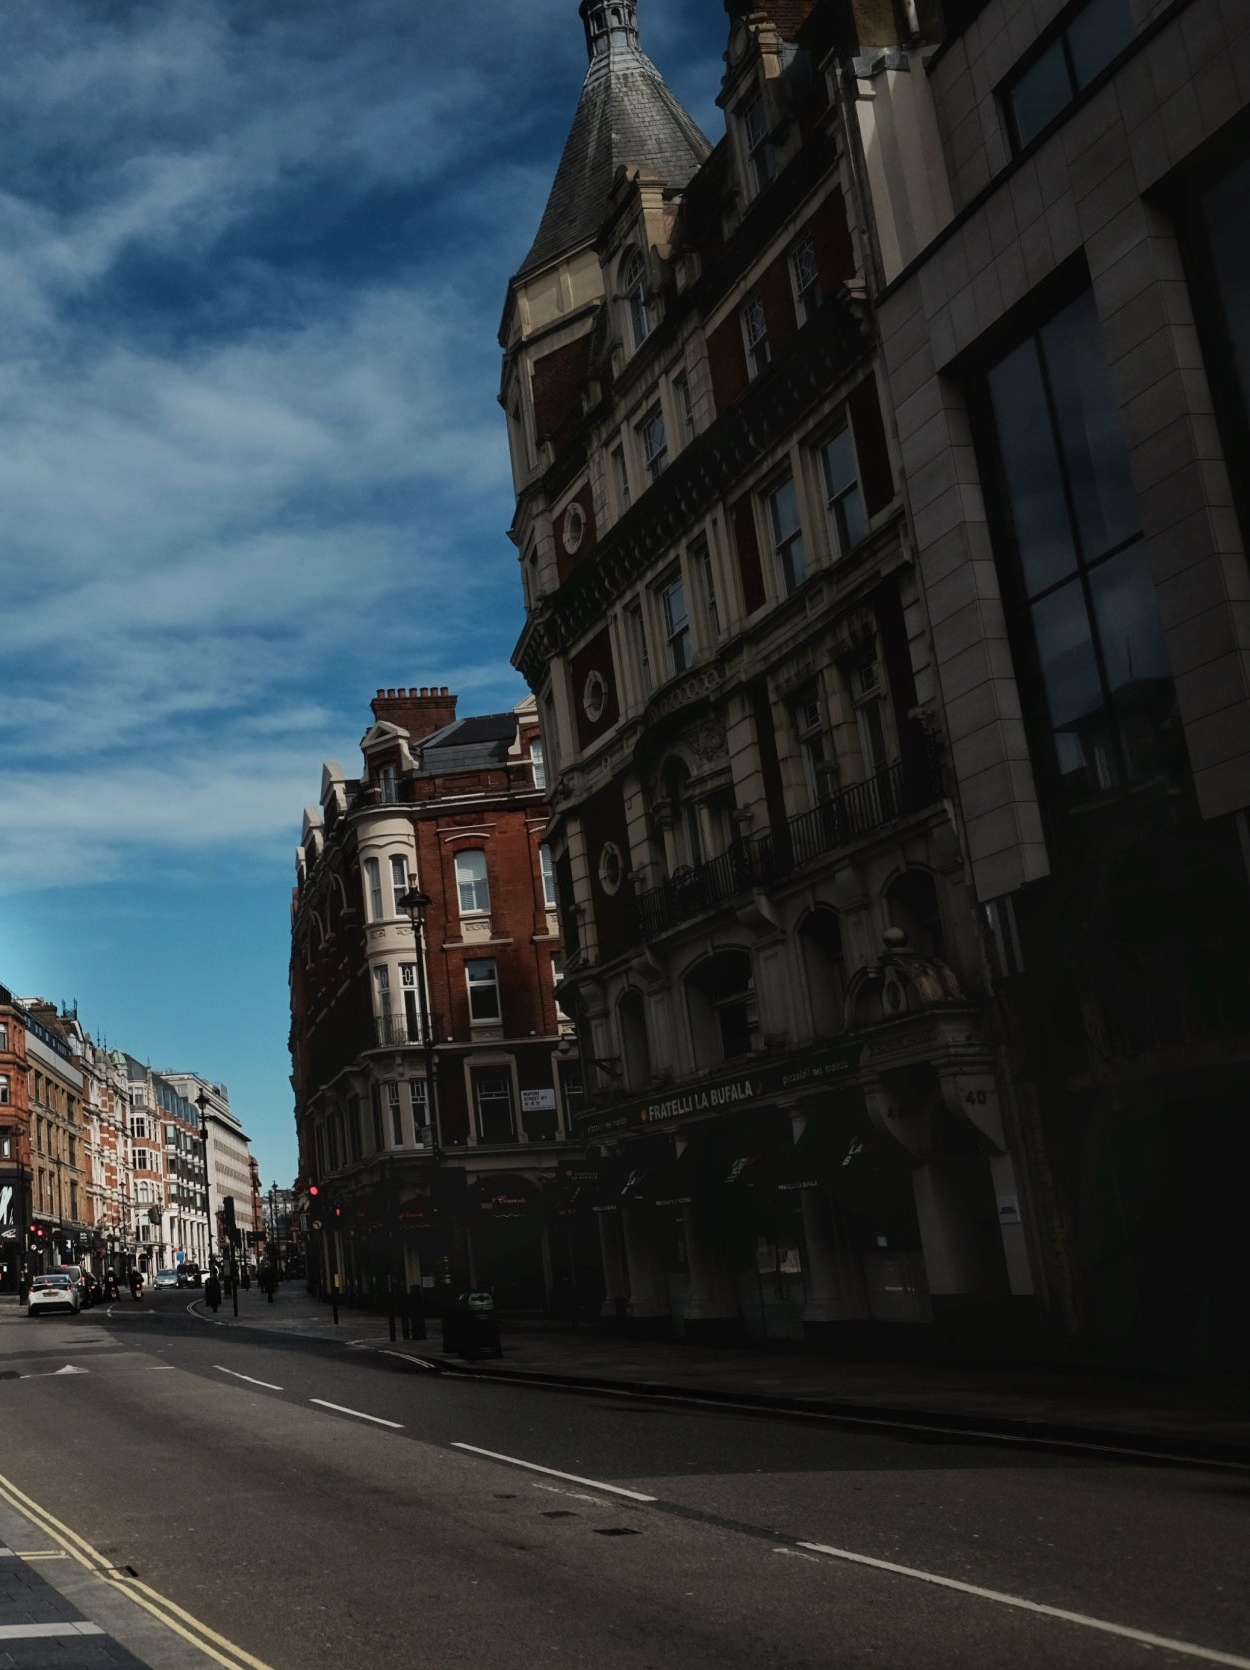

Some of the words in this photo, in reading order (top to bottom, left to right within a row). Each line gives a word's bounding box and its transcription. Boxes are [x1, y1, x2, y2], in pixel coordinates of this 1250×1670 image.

[648, 1095, 693, 1122] FRATELLI
[694, 1092, 709, 1110] LA
[710, 1080, 754, 1106] BUFALA
